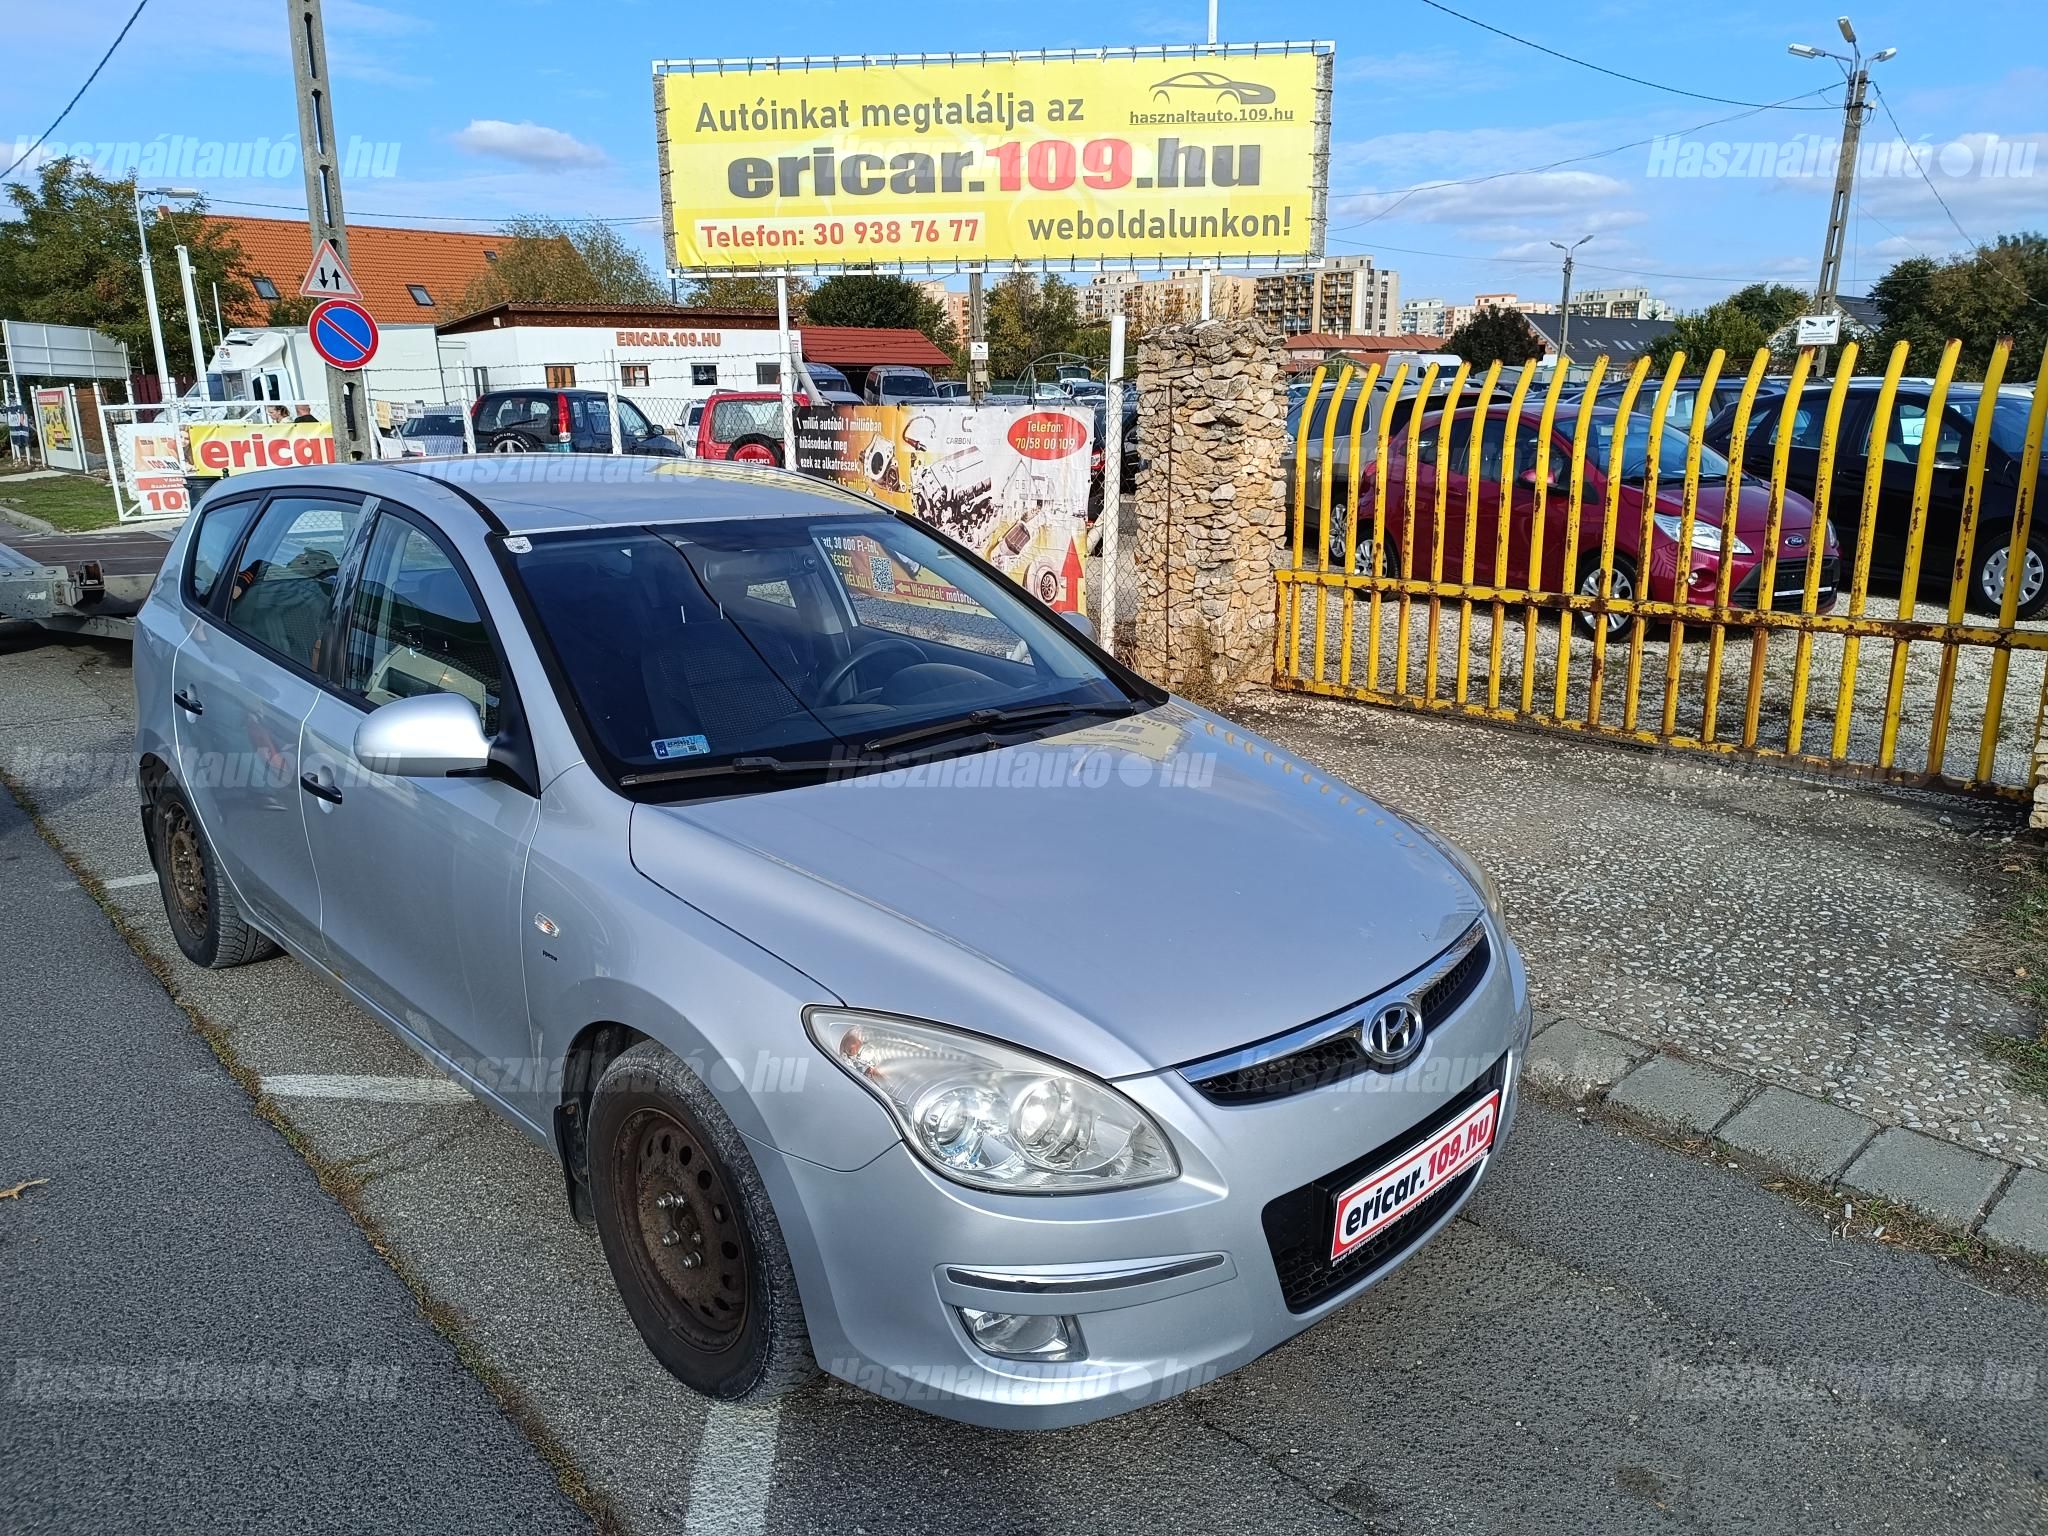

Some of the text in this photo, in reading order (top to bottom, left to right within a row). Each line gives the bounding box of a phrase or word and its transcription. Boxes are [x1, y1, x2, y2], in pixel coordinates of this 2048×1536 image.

[695, 89, 1084, 133] Autóinkat megtalálja az
[1129, 107, 1294, 125] hasznaltauto.109.hu
[727, 137, 1261, 199] ericar.109.hu
[1028, 206, 1291, 240] weboldalunkon!
[701, 219, 979, 247] Telefon: 30 938 76 77
[615, 331, 721, 347] ERICAR.109.HU
[820, 416, 843, 430] autóból
[850, 416, 881, 432] millióban
[1027, 420, 1063, 433] Telefon:
[800, 435, 848, 454] hibásodnak meg
[946, 437, 972, 445] CARBON
[1015, 437, 1040, 451] 70/58
[1043, 438, 1056, 450] 00
[1059, 437, 1076, 450] 109
[801, 455, 860, 473] ezek az alkatrészek,
[843, 538, 856, 551] 000
[911, 582, 945, 600] Weboldal:
[1345, 1114, 1489, 1236] ericar.109.hu
